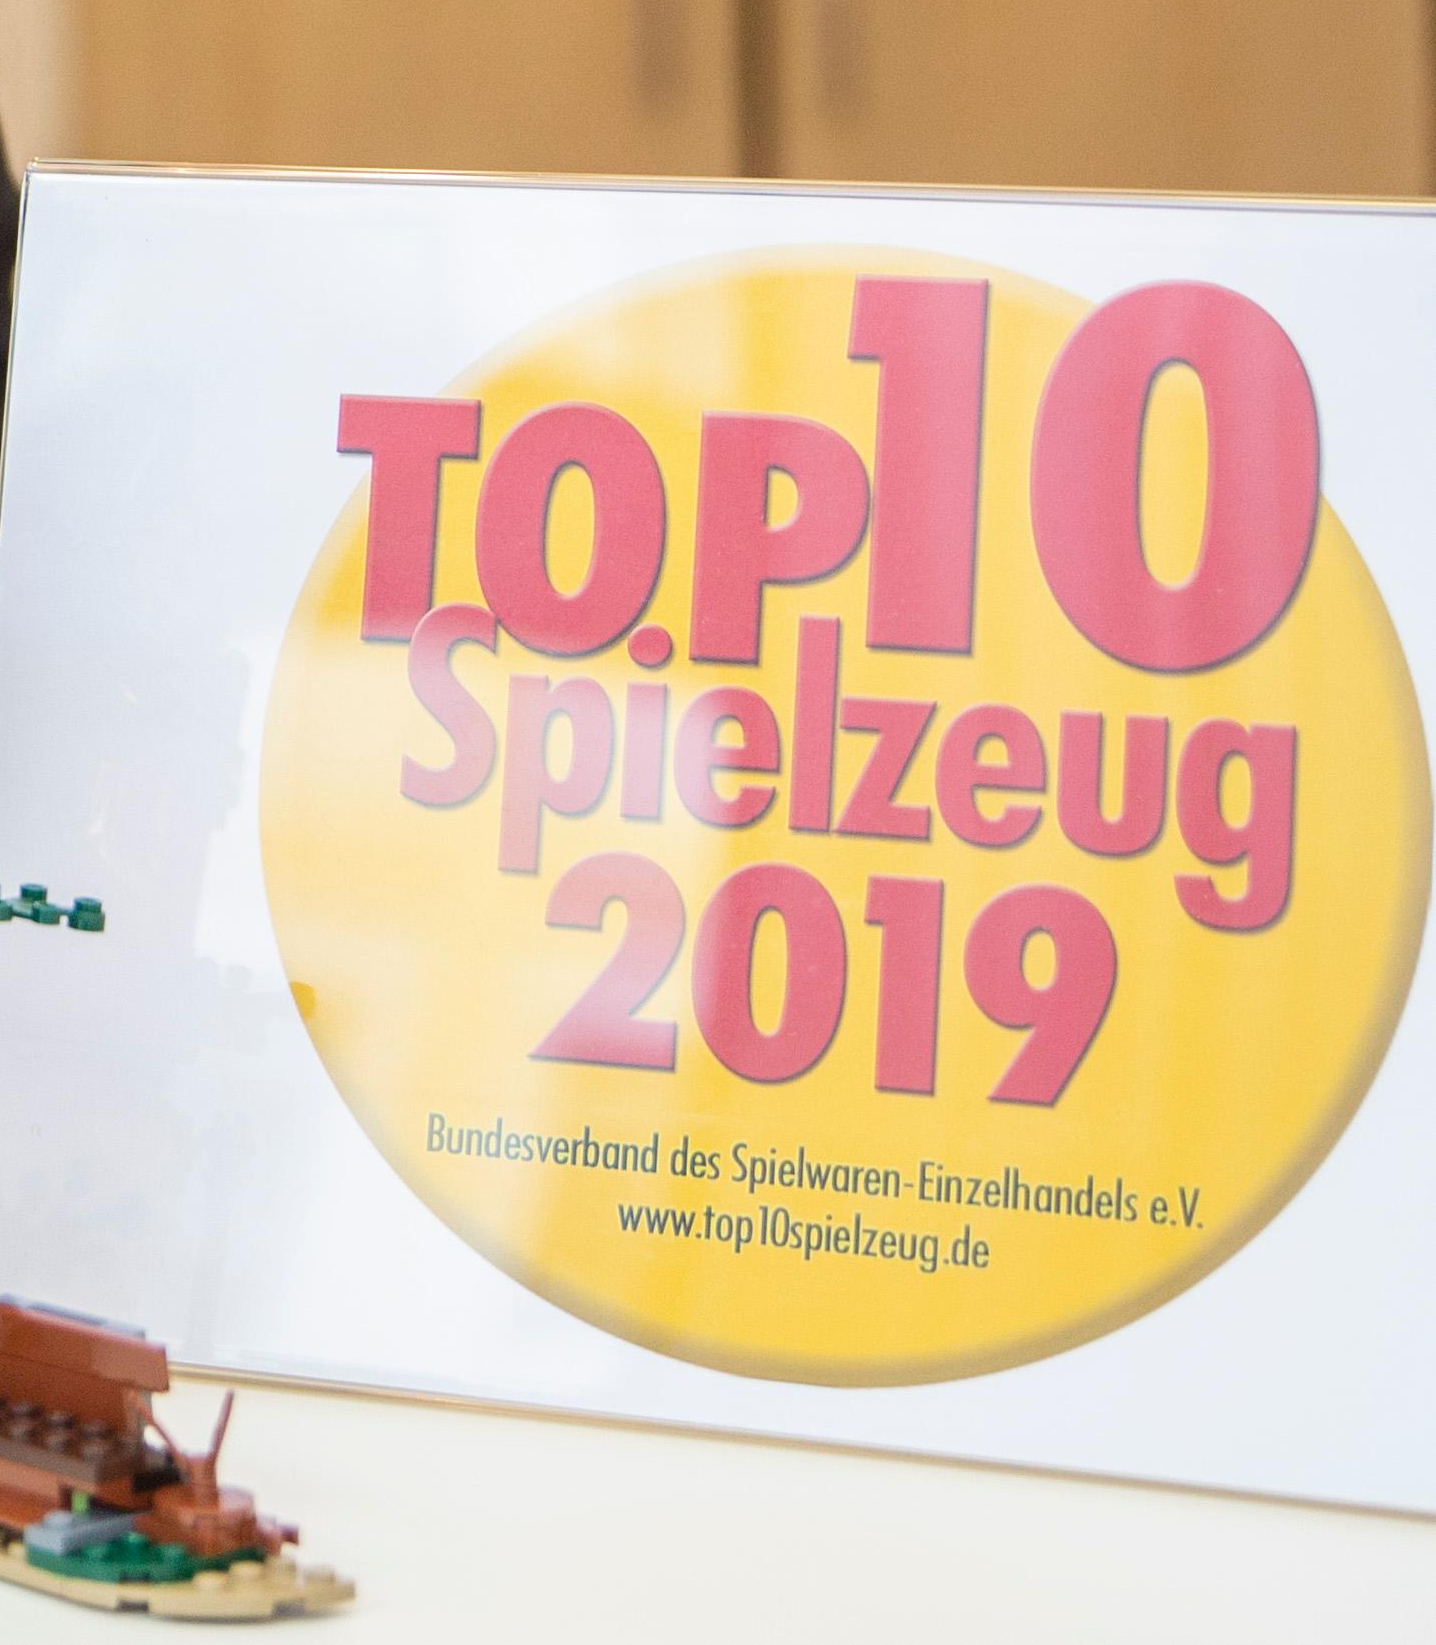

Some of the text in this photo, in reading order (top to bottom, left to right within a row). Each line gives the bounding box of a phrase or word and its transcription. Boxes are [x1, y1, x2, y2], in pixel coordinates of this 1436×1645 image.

[845, 273, 1323, 676] 10
[399, 602, 1300, 936] Spielzeug
[528, 850, 1119, 1107] 2019
[426, 1112, 1204, 1229] Bundesverband des Spielwaren-Einzelhandels e.V.
[617, 1203, 990, 1274] www.top10spielzeug.de
